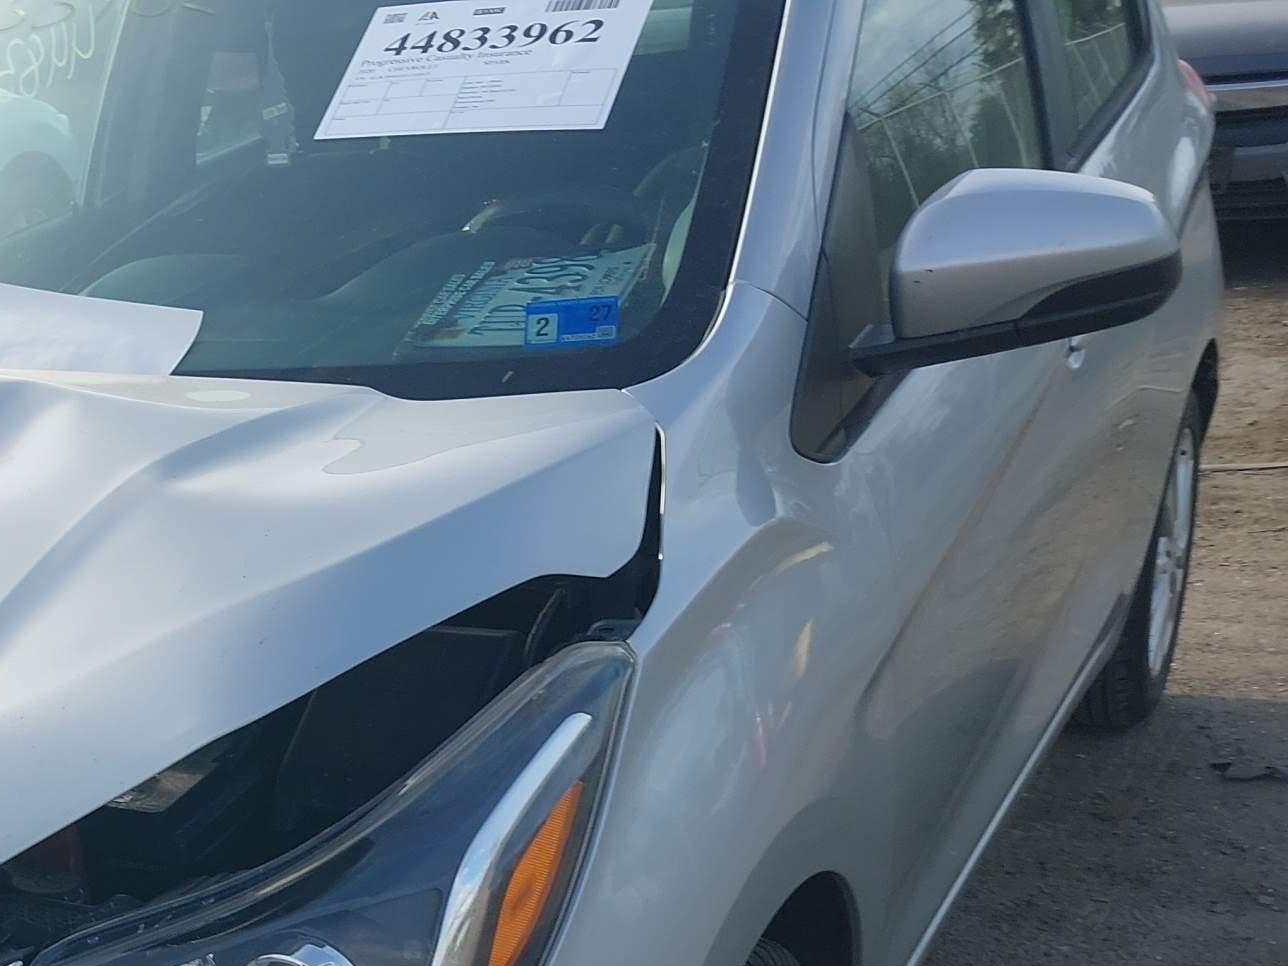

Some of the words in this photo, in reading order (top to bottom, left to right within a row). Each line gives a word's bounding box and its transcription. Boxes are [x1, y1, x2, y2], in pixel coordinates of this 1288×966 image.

[383, 19, 605, 56] 44833962
[360, 57, 421, 68] Progressive
[535, 316, 550, 337] 2
